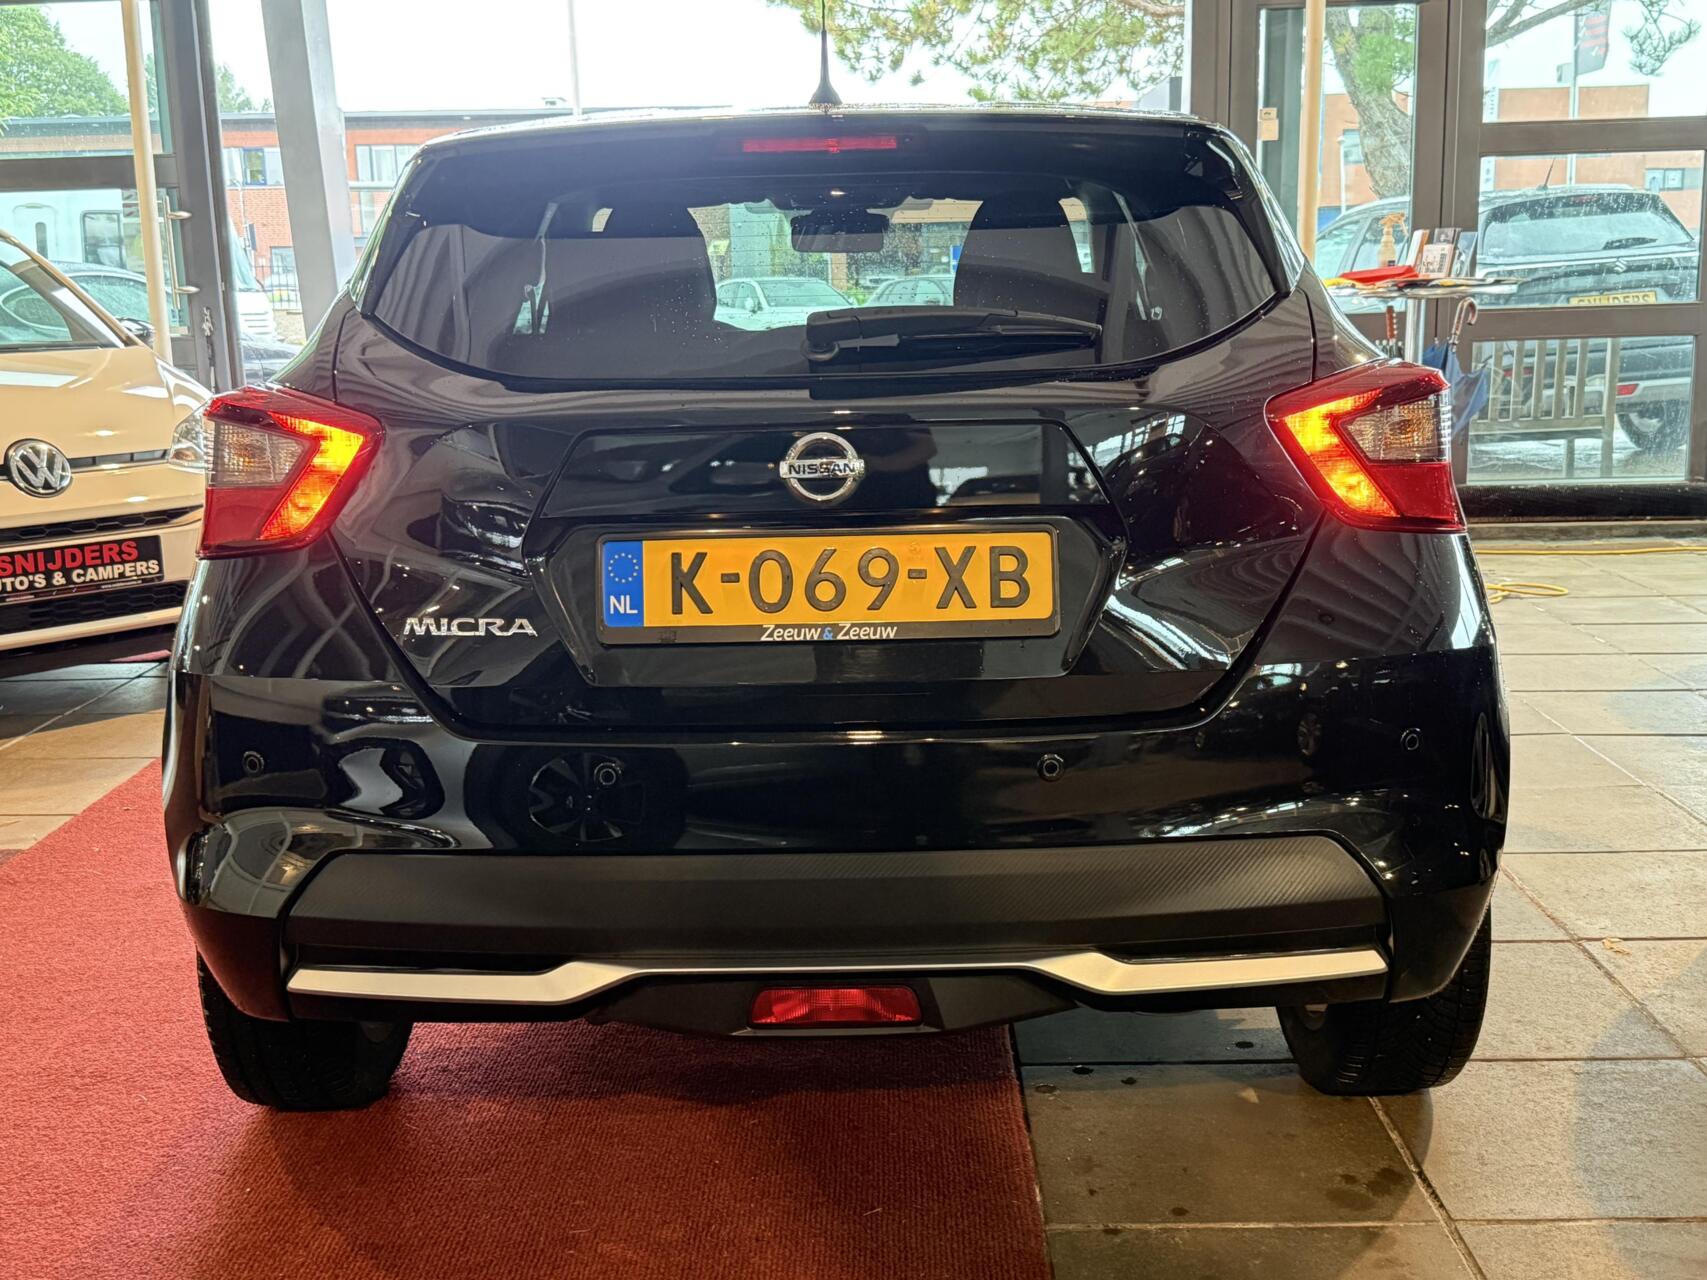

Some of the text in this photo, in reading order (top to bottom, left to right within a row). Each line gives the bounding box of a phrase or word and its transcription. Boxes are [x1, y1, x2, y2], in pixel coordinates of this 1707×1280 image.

[788, 463, 855, 475] NISSAN
[0, 541, 139, 576] SNIJDERS
[52, 572, 66, 586] &
[72, 560, 160, 583] CAMPERS
[670, 544, 1031, 615] K-069-XB
[609, 595, 638, 614] NL
[403, 617, 538, 637] MICRA
[760, 623, 897, 642] Zeeuw & Zeeuw
